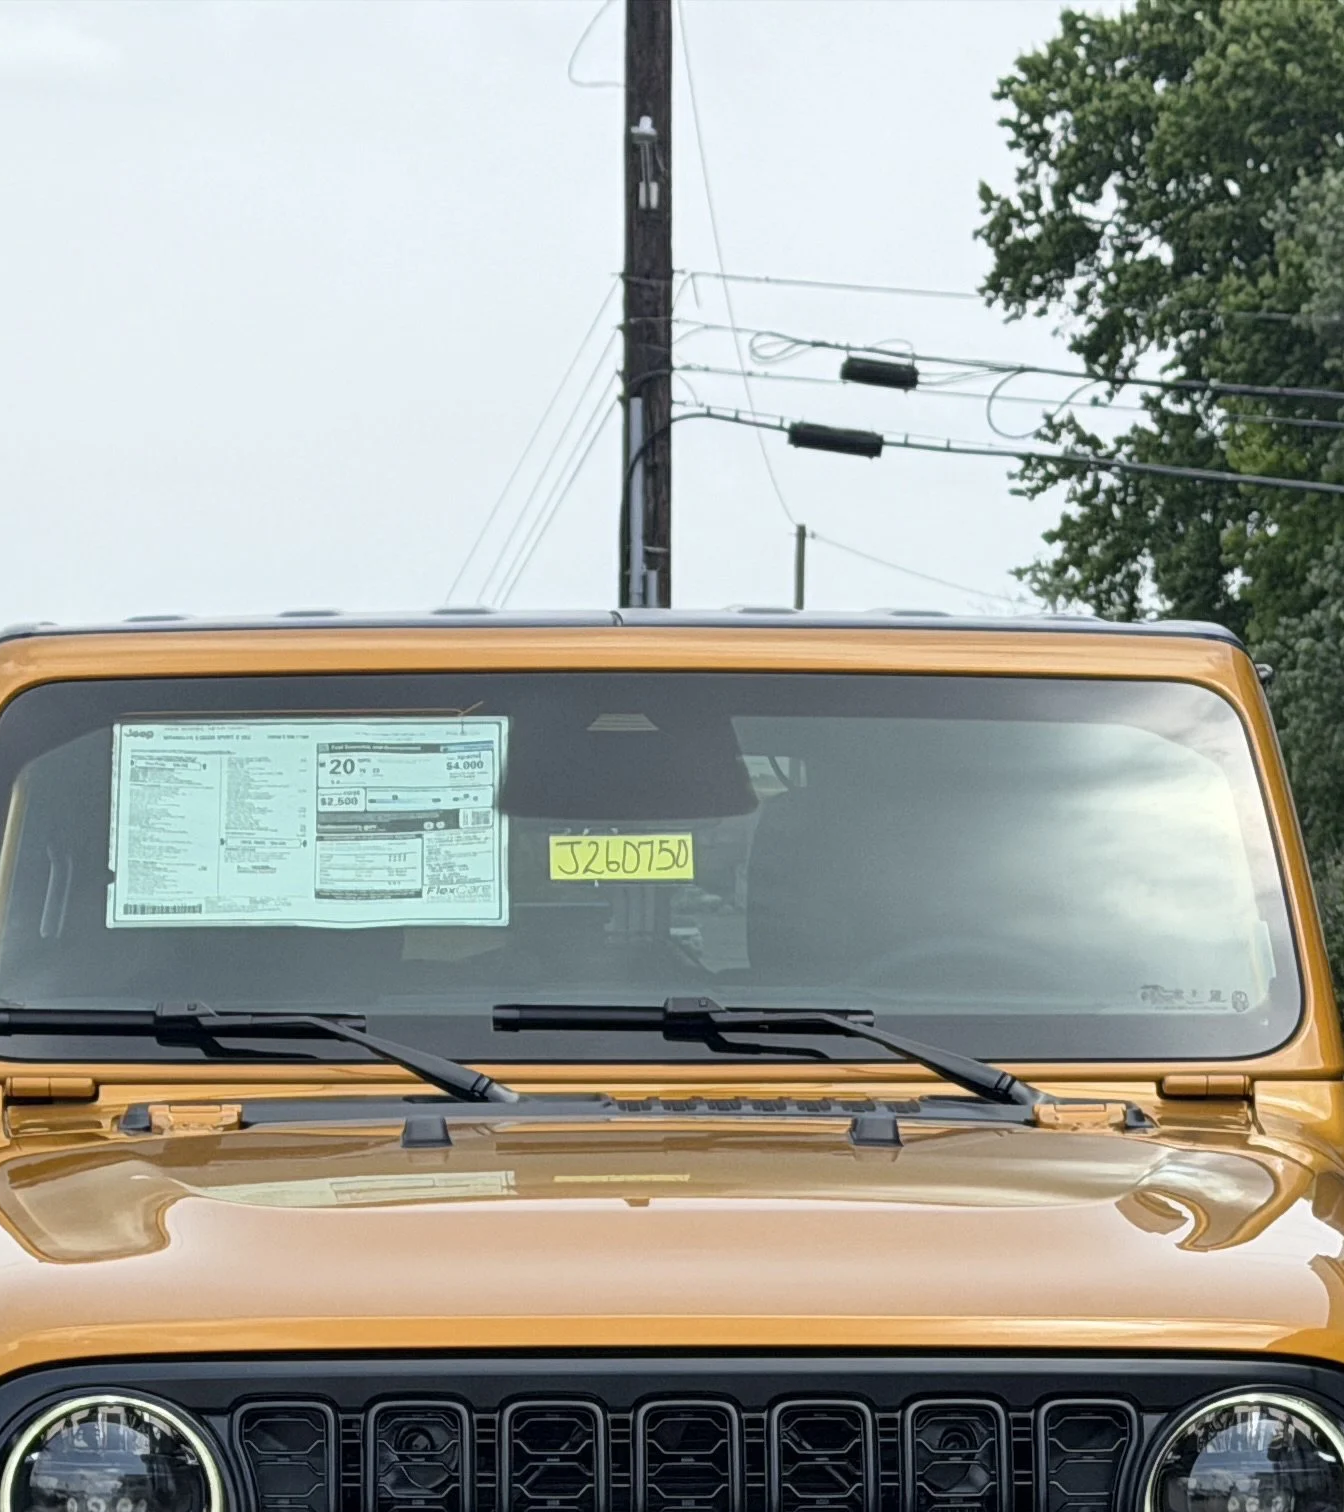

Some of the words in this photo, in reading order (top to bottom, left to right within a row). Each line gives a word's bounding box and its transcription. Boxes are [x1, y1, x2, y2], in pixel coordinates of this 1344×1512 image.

[124, 729, 154, 740] Jeep
[329, 758, 355, 775] 20
[555, 839, 689, 875] J260750
